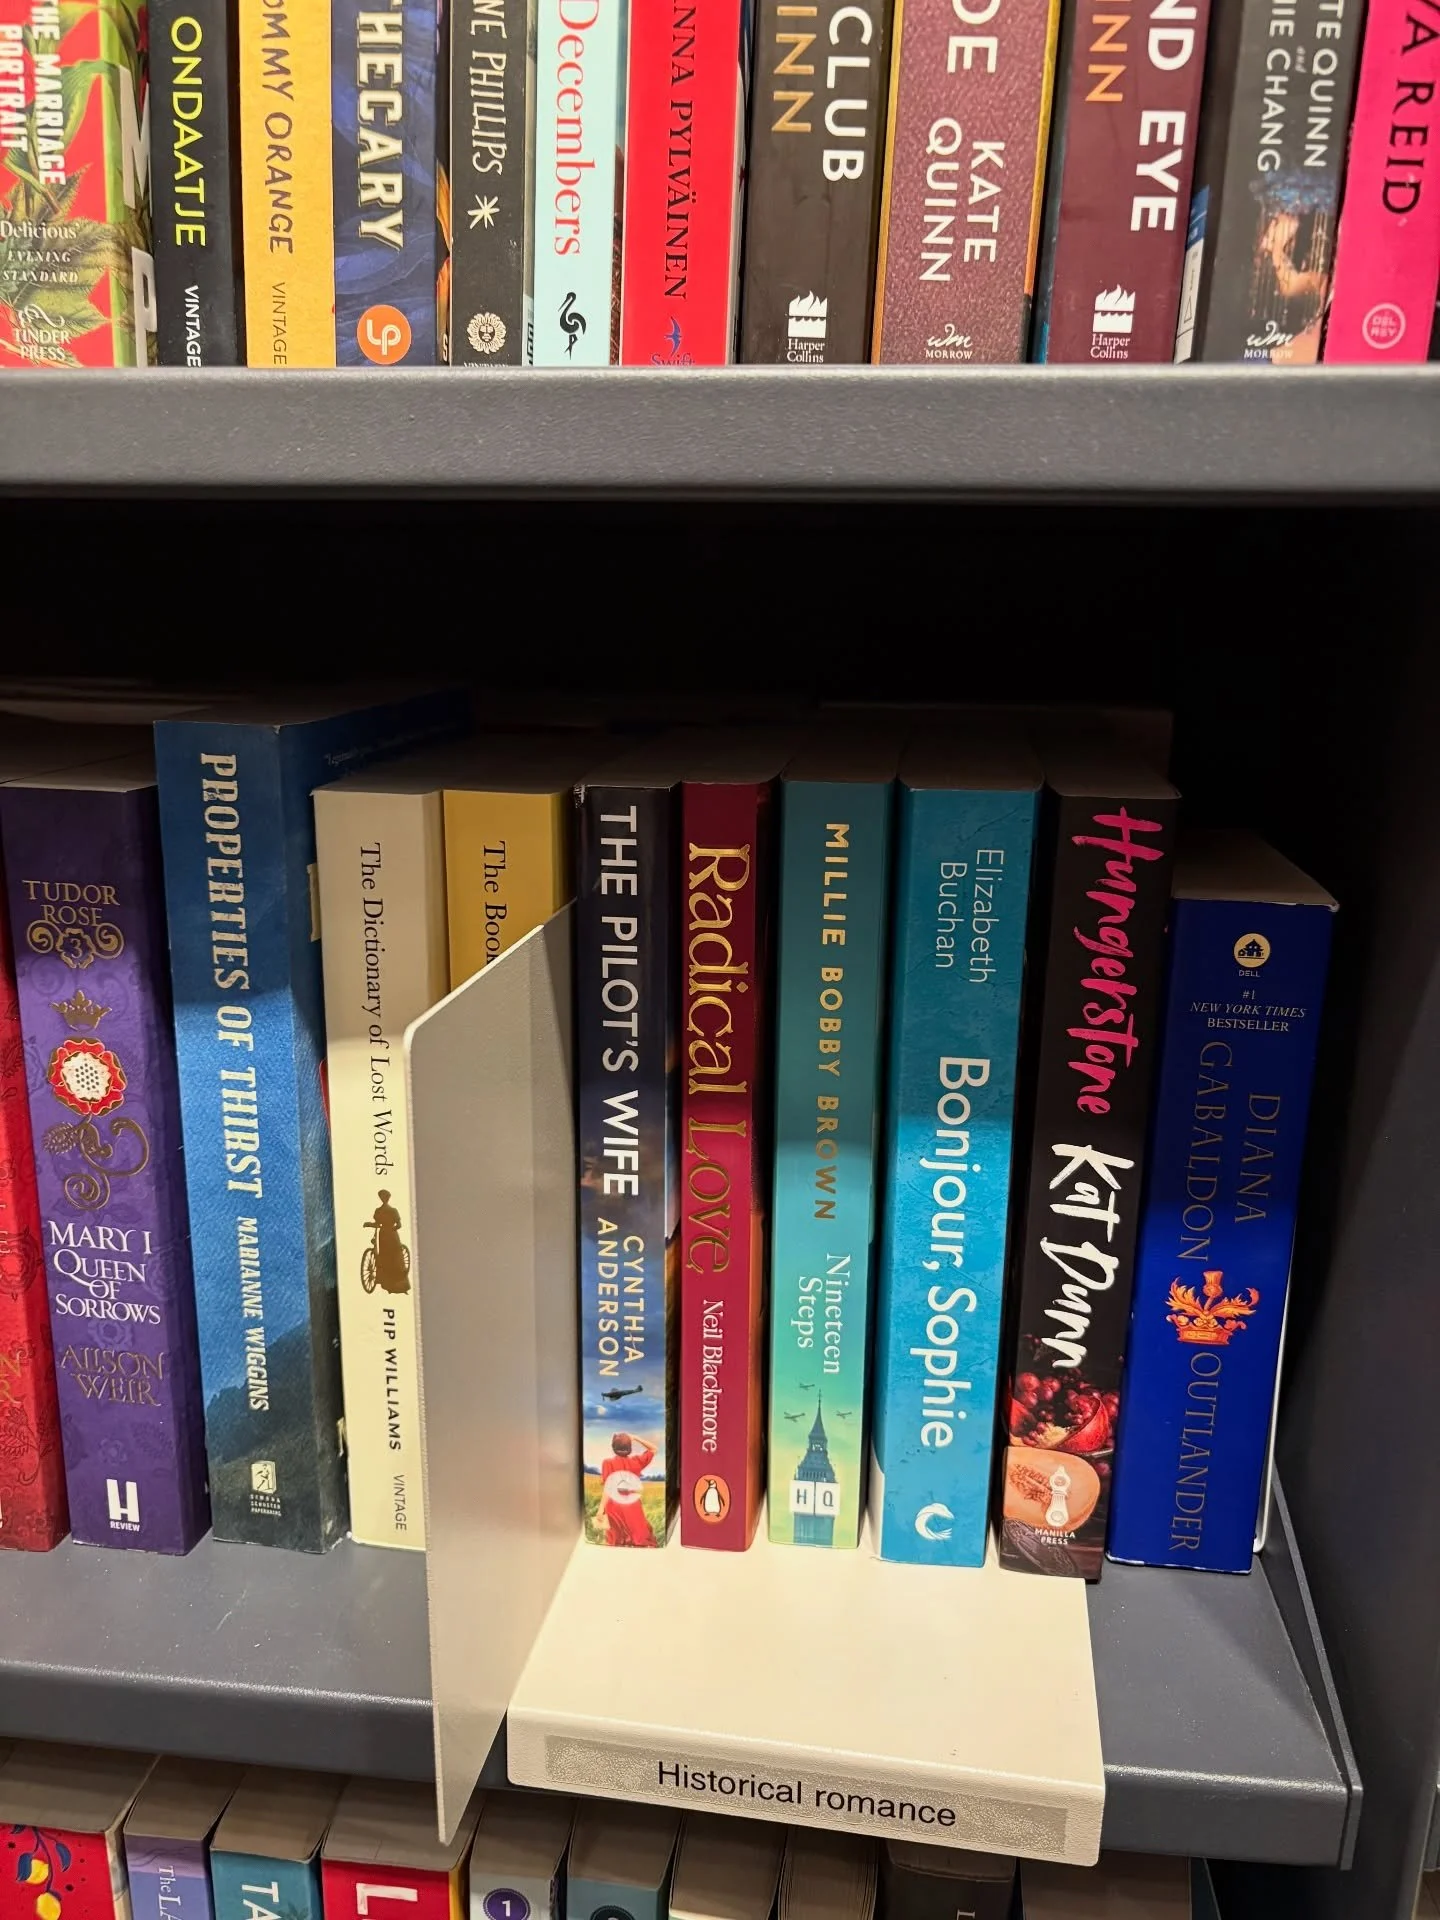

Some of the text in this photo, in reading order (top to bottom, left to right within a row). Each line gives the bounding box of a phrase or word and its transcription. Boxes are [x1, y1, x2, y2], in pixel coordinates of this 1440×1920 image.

[0, 24, 28, 152] PORTRAIT
[31, 0, 66, 185] HE MARRIAGE
[822, 6, 873, 182] CLUB
[1085, 0, 1132, 102] NN
[1257, 0, 1297, 172] IE CHANG
[1303, 48, 1338, 167] QUINN
[1382, 0, 1440, 214] A REID
[171, 16, 206, 247] ONDAATJE
[262, 0, 295, 254] MMY ORANGE
[357, 0, 403, 250] HECARY
[469, 50, 507, 175] PHILLIPS
[554, 0, 599, 256] Decembers
[665, 0, 697, 299] NNA PYLVÄINEN
[919, 117, 963, 282] QUINN
[964, 141, 1005, 263] KATE
[1130, 110, 1186, 231] EYE
[2, 270, 79, 283] STANDARD
[8, 250, 71, 263] EVENING
[14, 329, 71, 344] TINDER
[20, 346, 66, 361] PRESS
[184, 285, 201, 367] VINTAGE
[271, 282, 287, 364] VINTAGE
[787, 350, 824, 363] Collins
[788, 338, 825, 352] Harper
[924, 349, 973, 360] MORROW
[1090, 345, 1129, 359] Collins
[1092, 333, 1131, 347] Harper
[1244, 348, 1292, 359] MORROW
[22, 880, 120, 906] TUDOR
[41, 904, 103, 927] ROSE
[484, 841, 506, 892] The
[935, 862, 967, 969] Buchan
[969, 849, 1004, 983] Elizabeth
[70, 938, 83, 959] 3
[201, 752, 264, 1199] PROPERTIES OF THIRST
[600, 806, 639, 1196] THE PILOT’S WIFE
[1068, 807, 1164, 1115] Hungerstone
[1239, 969, 1260, 977] DELL
[360, 842, 393, 1176] The Dictionary of Lost Words
[686, 842, 750, 1273] Radical Love
[814, 823, 850, 1219] MILLIE BOBBY BROWN
[1190, 1002, 1307, 1018] NEW YORK TIMES
[1208, 1018, 1289, 1032] BESTSELLER
[1176, 1042, 1232, 1262] GABALDON
[1235, 1092, 1281, 1223] DIANA
[49, 1221, 137, 1252] MARY
[89, 1280, 121, 1301] OF
[910, 1056, 990, 1448] Bonjour, Sophie
[1040, 1142, 1135, 1368] Kat Dunn
[55, 1296, 161, 1325] SORROWS
[237, 1216, 269, 1412] MARIANNE WIGGINS
[597, 1217, 619, 1376] ANDERSON
[623, 1235, 645, 1363] CYNTHIA
[790, 1276, 822, 1349] Steps
[823, 1253, 851, 1375] Nineteen
[60, 1344, 164, 1380] ALISON
[71, 1374, 160, 1406] WEIR
[382, 1308, 401, 1451] PIP WILLIAMS
[702, 1300, 724, 1453] Neil Blackmore
[393, 1474, 407, 1530] VINTAGE
[1168, 1352, 1222, 1552] OUTLANDER
[110, 1521, 140, 1532] REVIEW
[1035, 1528, 1076, 1538] MANILLA
[1041, 1536, 1068, 1545] PRESS
[659, 1761, 957, 1828] Historical romance
[158, 1866, 176, 1893] The
